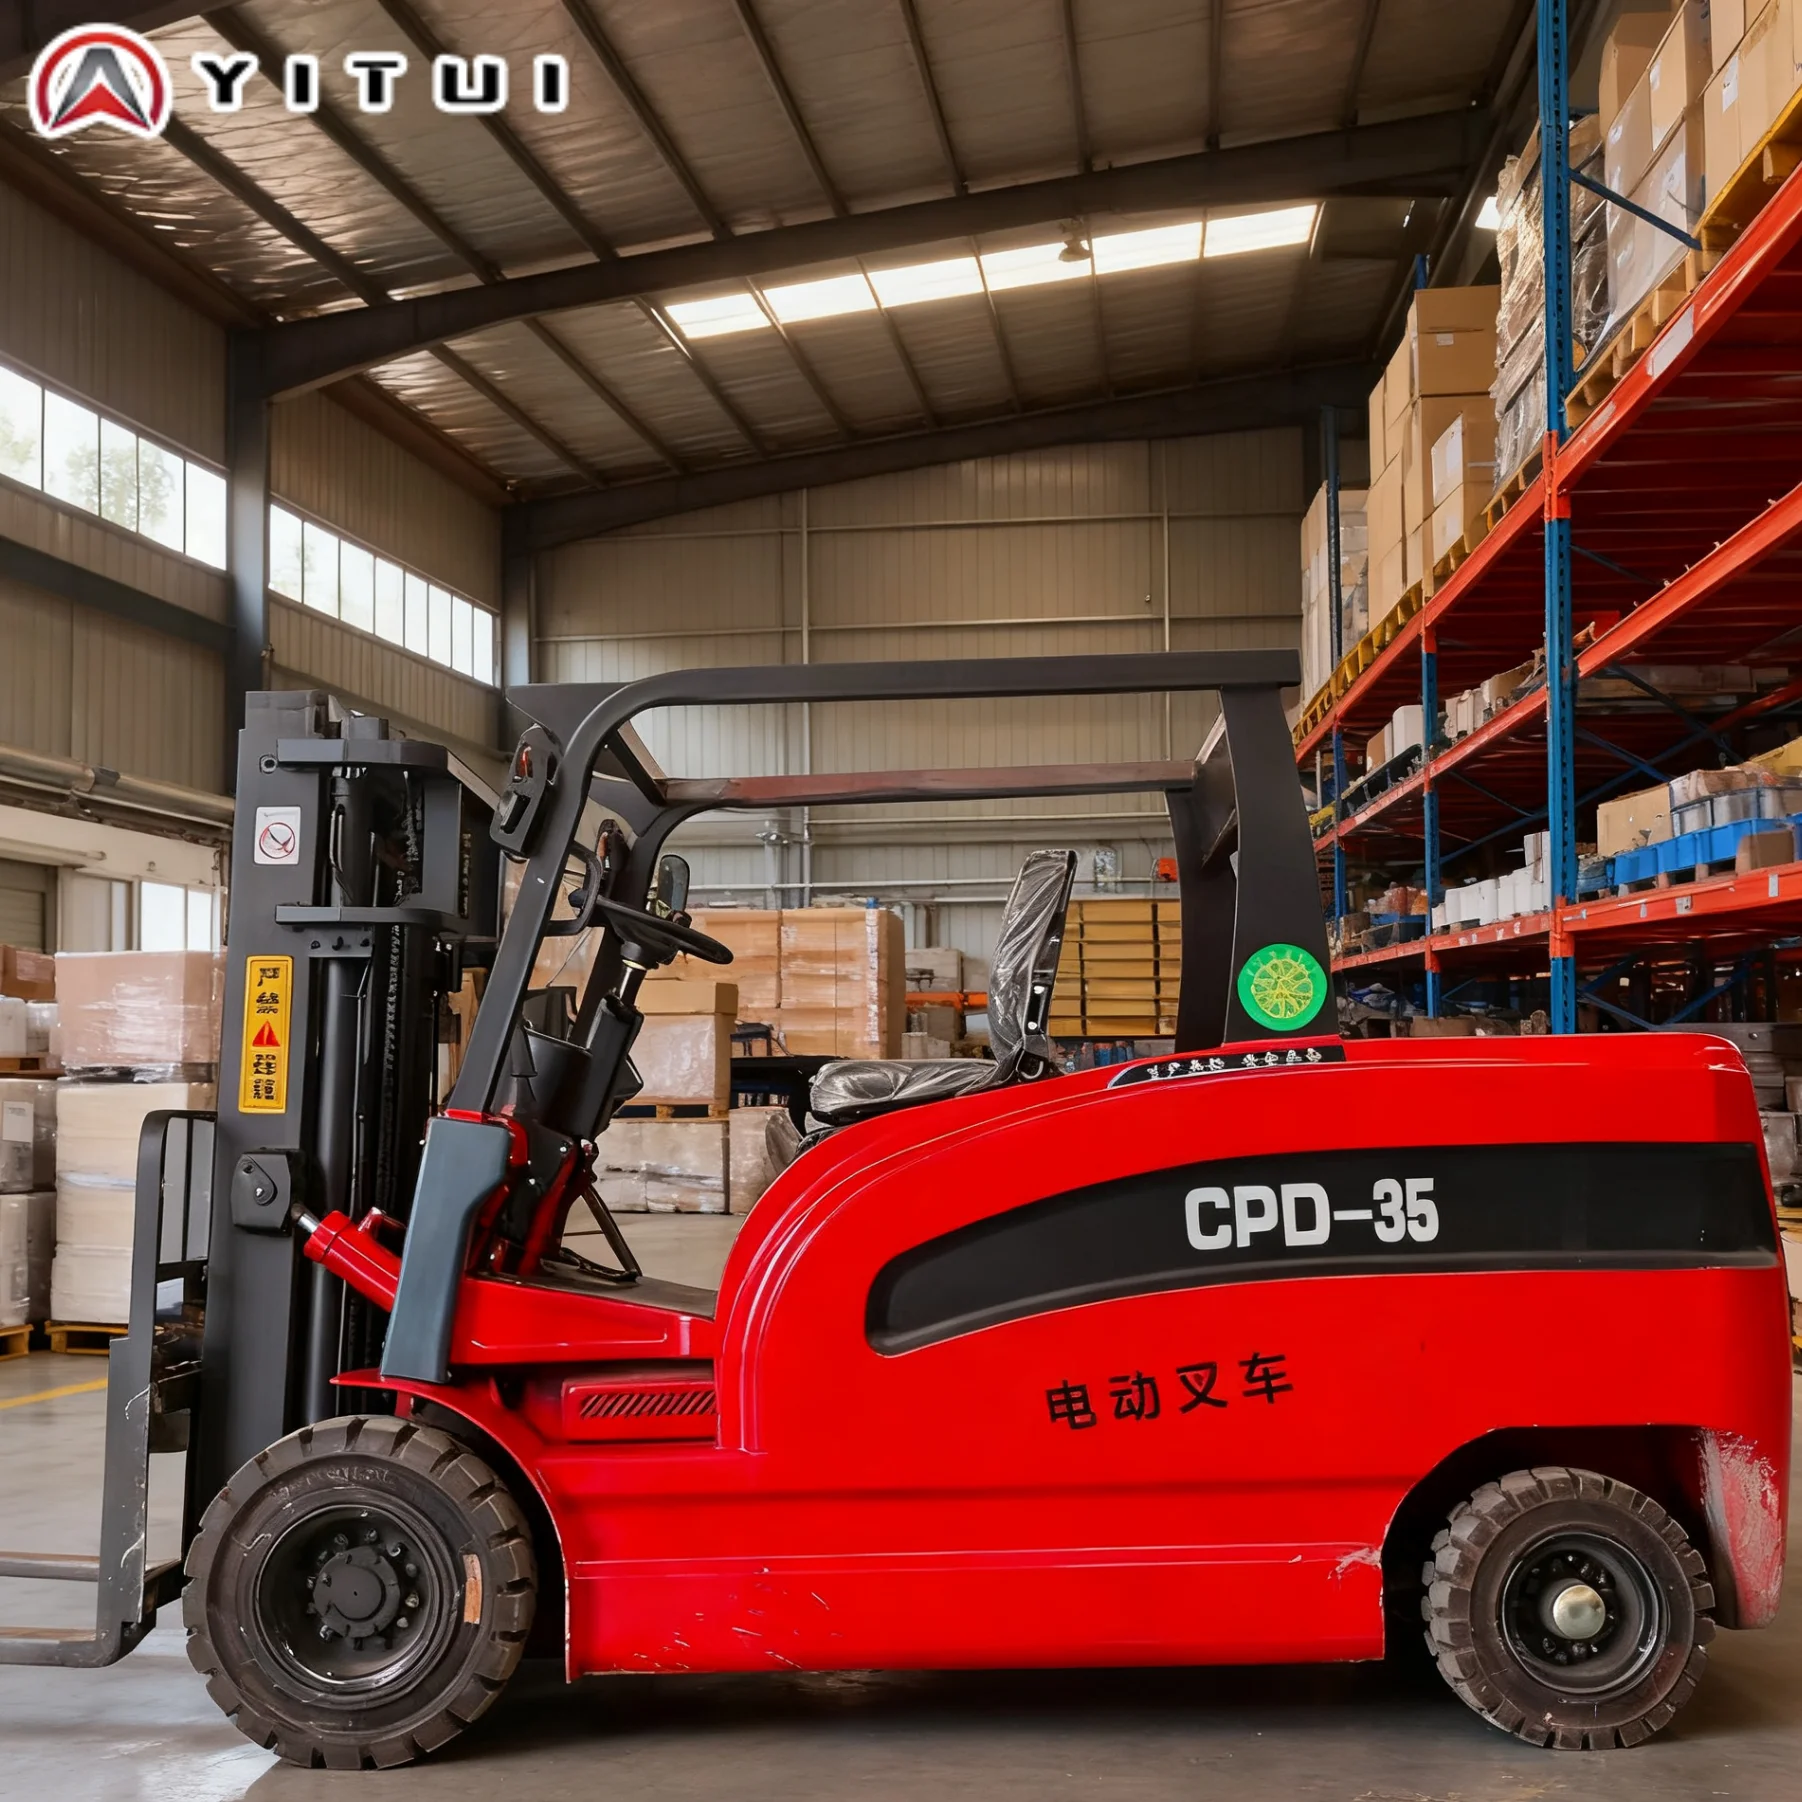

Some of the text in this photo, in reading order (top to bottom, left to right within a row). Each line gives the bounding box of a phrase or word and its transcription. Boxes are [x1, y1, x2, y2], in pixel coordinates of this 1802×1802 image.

[1185, 1178, 1439, 1250] CPD-35
[1046, 1352, 1293, 1430] 电动叉车
